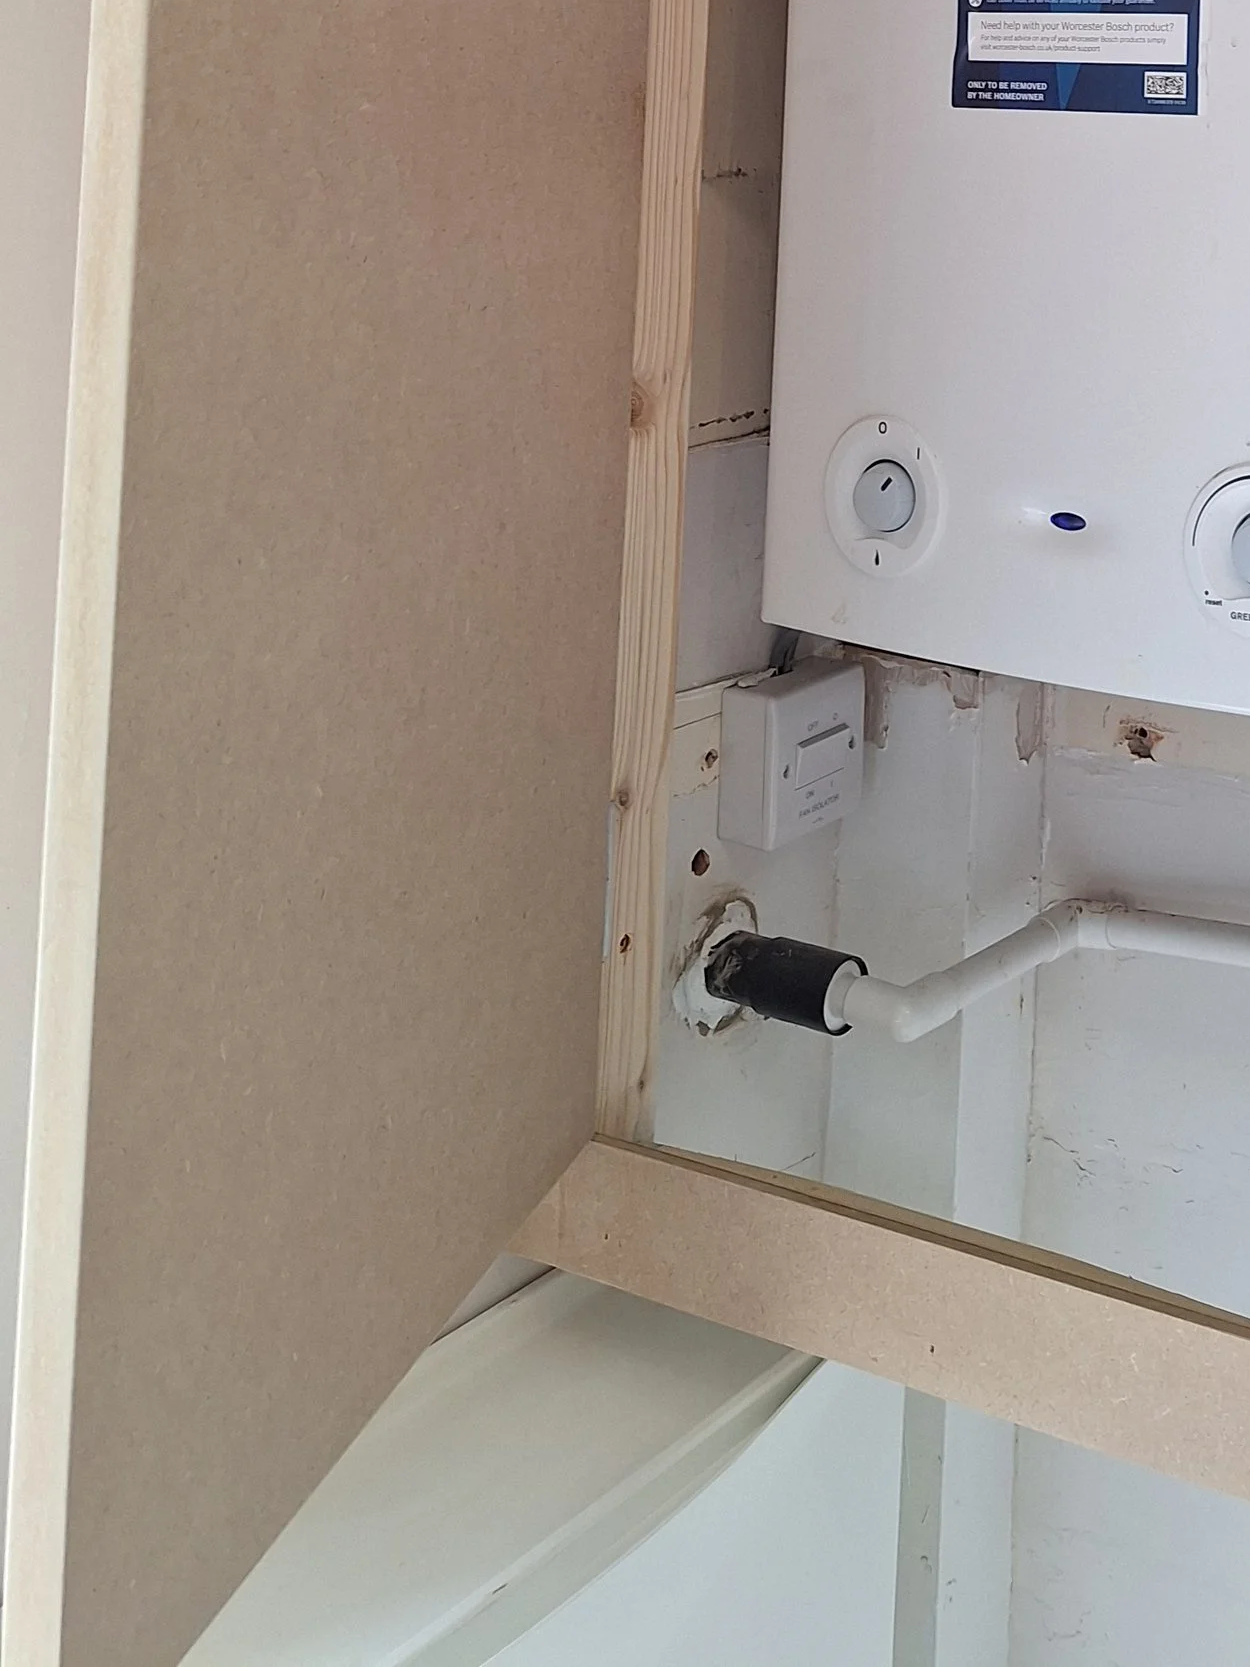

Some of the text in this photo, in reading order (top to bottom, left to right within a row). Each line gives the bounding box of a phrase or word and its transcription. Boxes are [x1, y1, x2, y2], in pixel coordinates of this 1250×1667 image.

[981, 20, 1174, 33] Need help with your Worcester Bosch product?
[990, 34, 1002, 42] help
[967, 81, 986, 89] ONLY
[987, 81, 998, 89] TO
[1010, 82, 1048, 90] REMOVED
[978, 92, 993, 100] THE
[994, 92, 1045, 101] HOMEOWNER
[799, 793, 840, 819] FAN ISOLATOR
